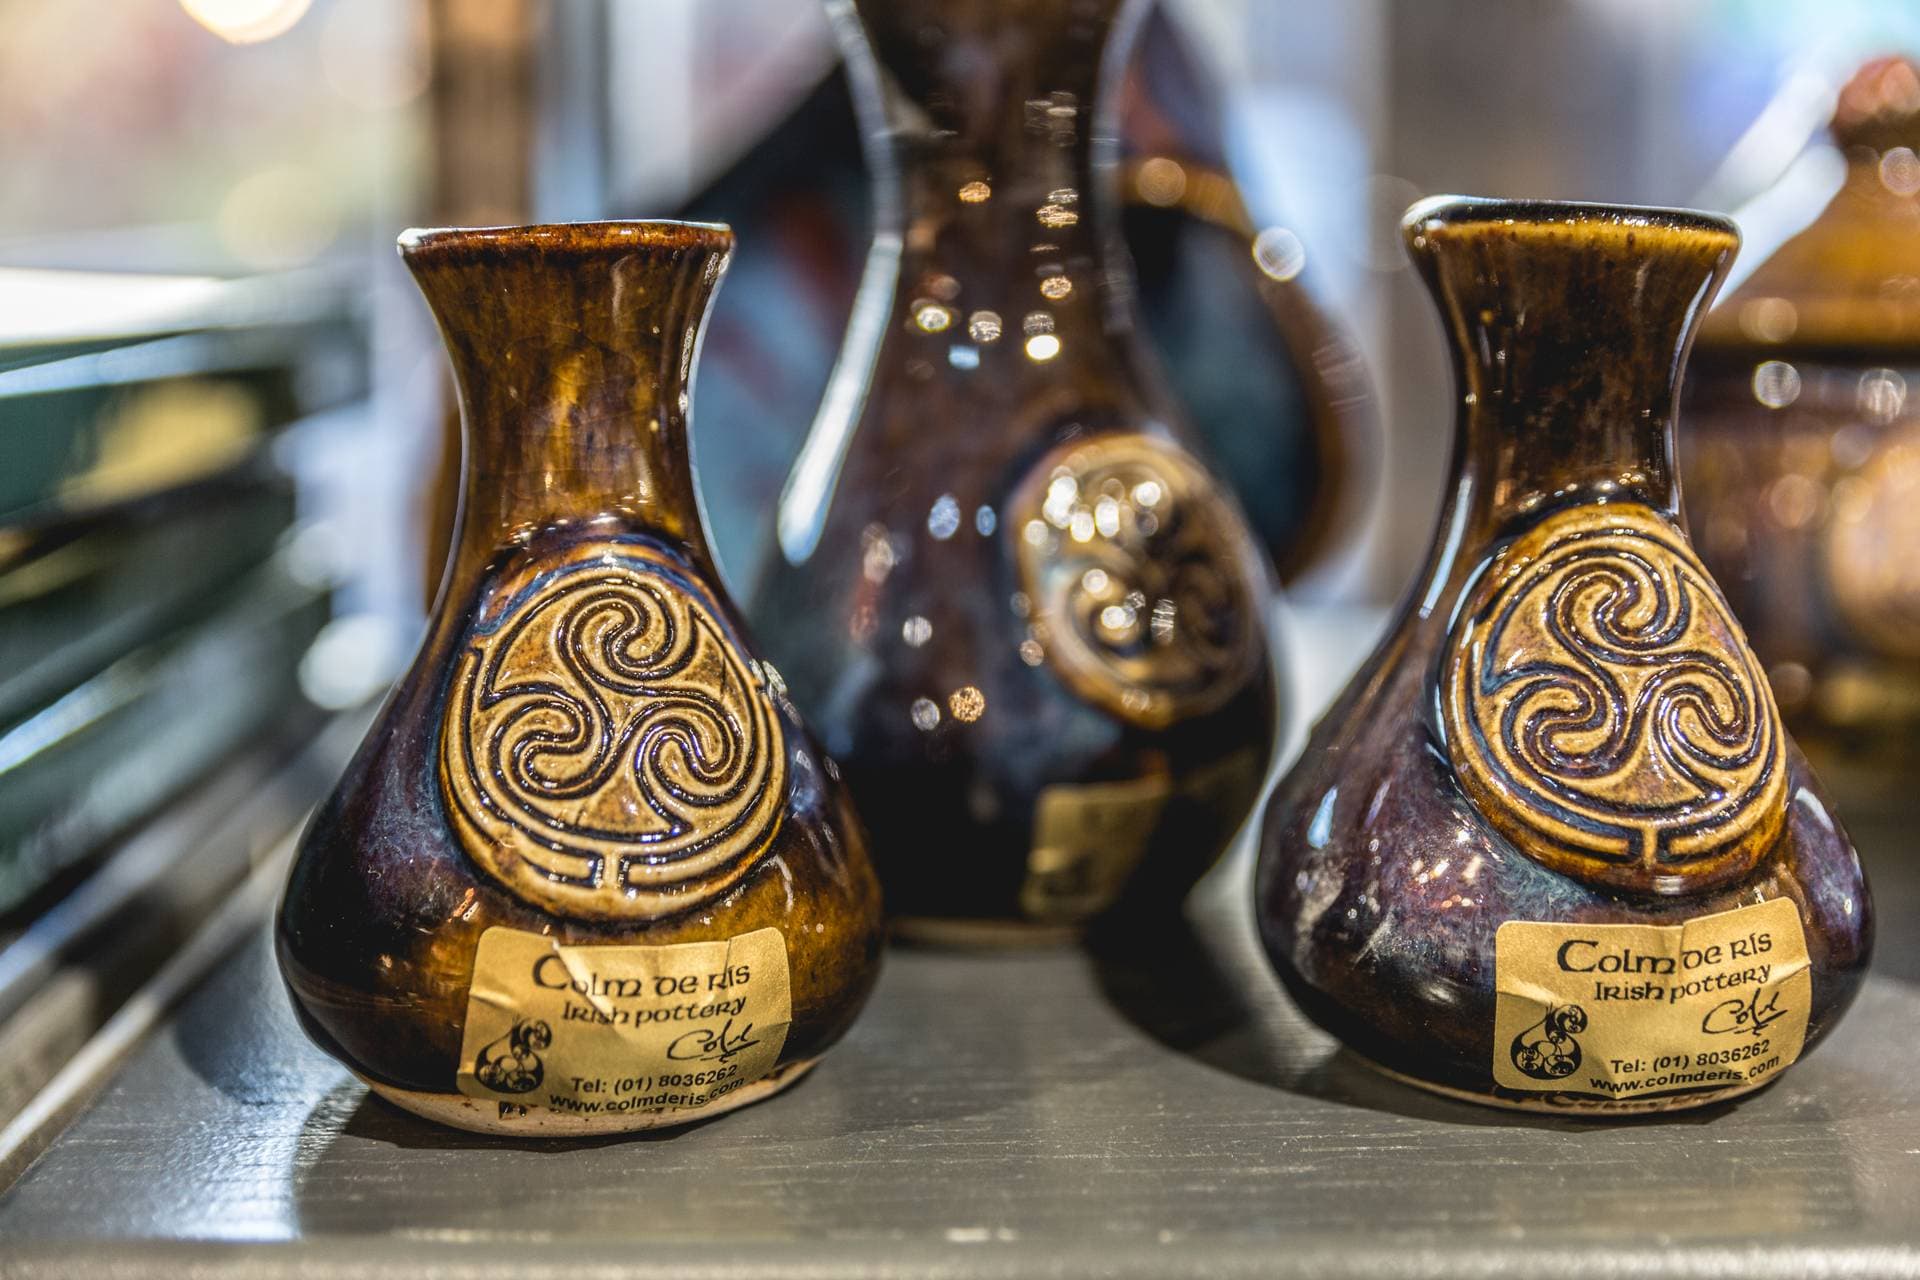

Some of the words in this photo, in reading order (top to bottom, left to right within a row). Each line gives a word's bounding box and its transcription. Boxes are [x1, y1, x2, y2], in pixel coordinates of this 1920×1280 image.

[1557, 939, 1675, 975] Colm
[1682, 945, 1723, 970] de
[532, 954, 642, 997] Colm
[1594, 980, 1666, 1003] Irish
[1669, 964, 1771, 1004] pottery
[634, 994, 748, 1028] pottery
[1589, 1054, 1780, 1094] www.colmderis.com
[1610, 1060, 1647, 1075] Tel:
[1652, 1055, 1690, 1073] (01)
[1696, 1038, 1771, 1066] 8036262
[549, 1077, 745, 1113] www.colmderis.com
[570, 1077, 607, 1094] Tel:
[613, 1077, 653, 1097] (01)
[658, 1064, 739, 1088] 8036262
